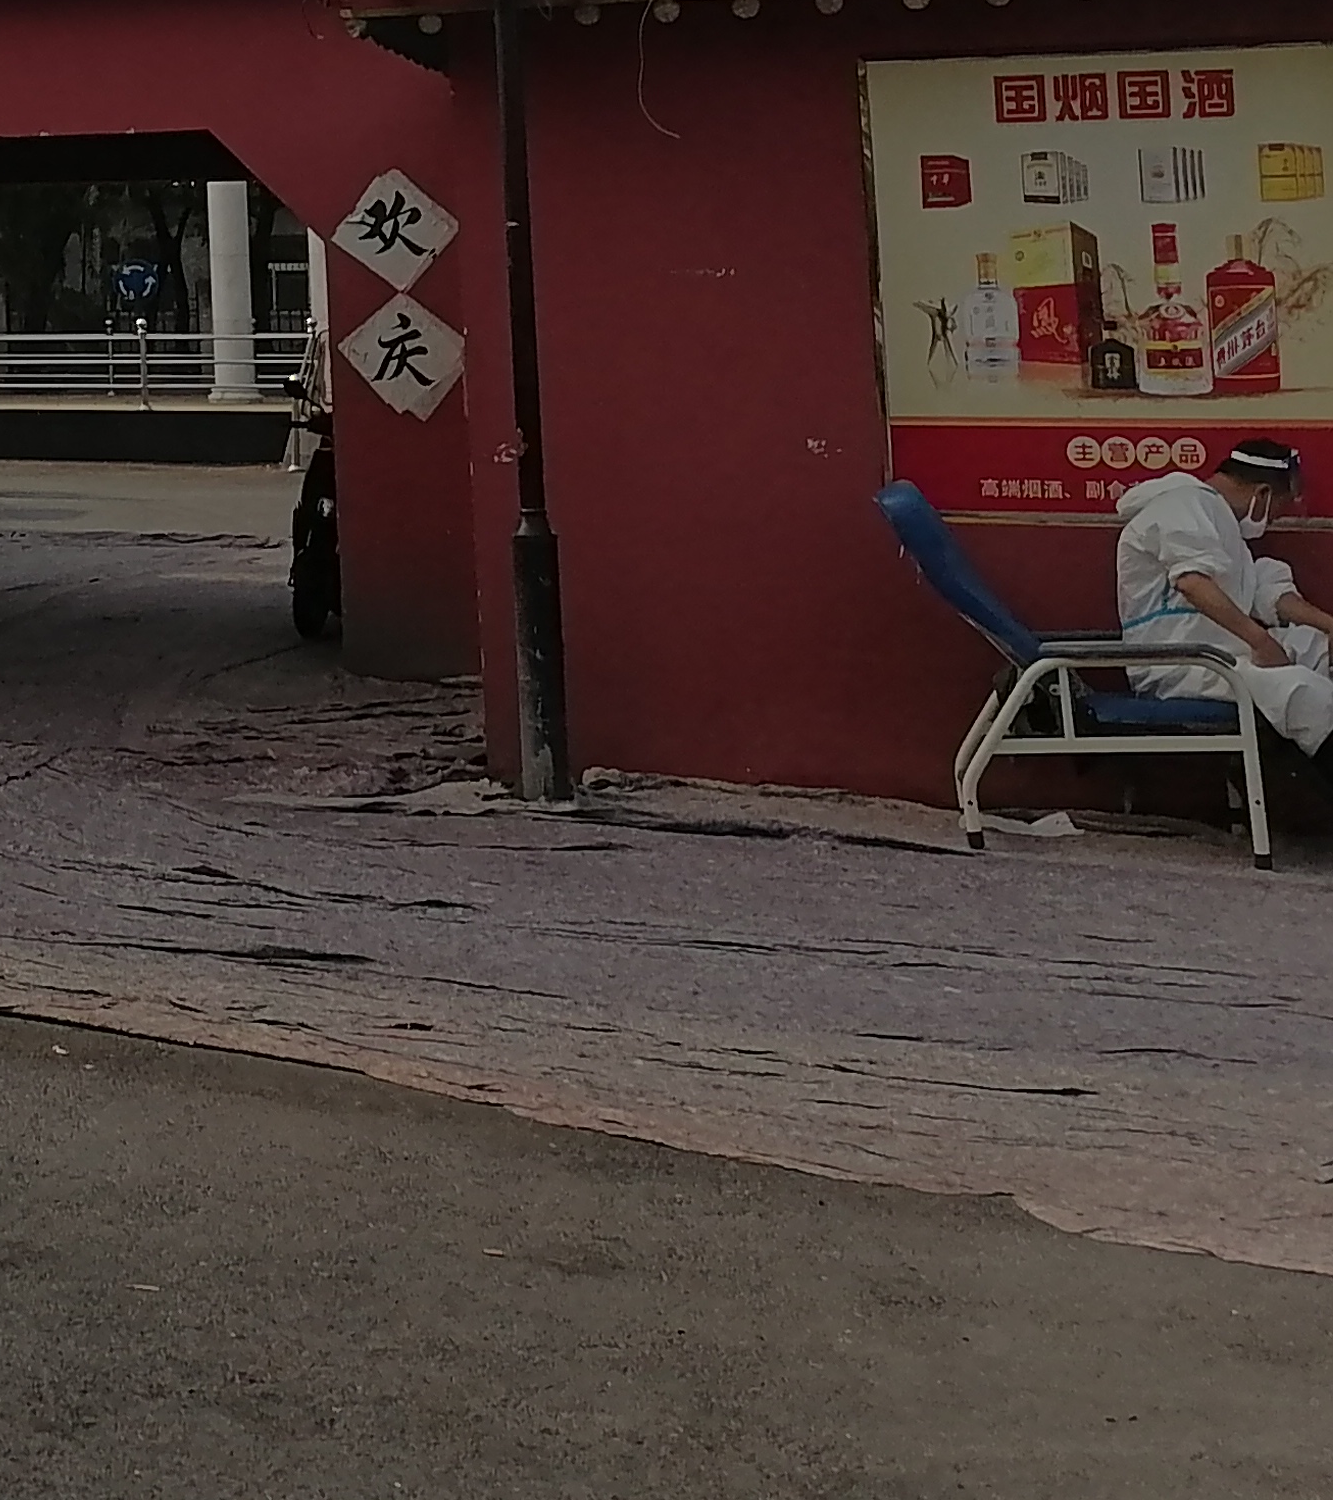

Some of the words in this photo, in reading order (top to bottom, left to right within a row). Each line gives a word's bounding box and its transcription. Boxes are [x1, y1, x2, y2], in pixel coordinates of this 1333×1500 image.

[993, 69, 1235, 123] 国烟国酒
[1072, 442, 1202, 466] 主营产品
[980, 479, 1140, 500] 高端烟酒、副食
